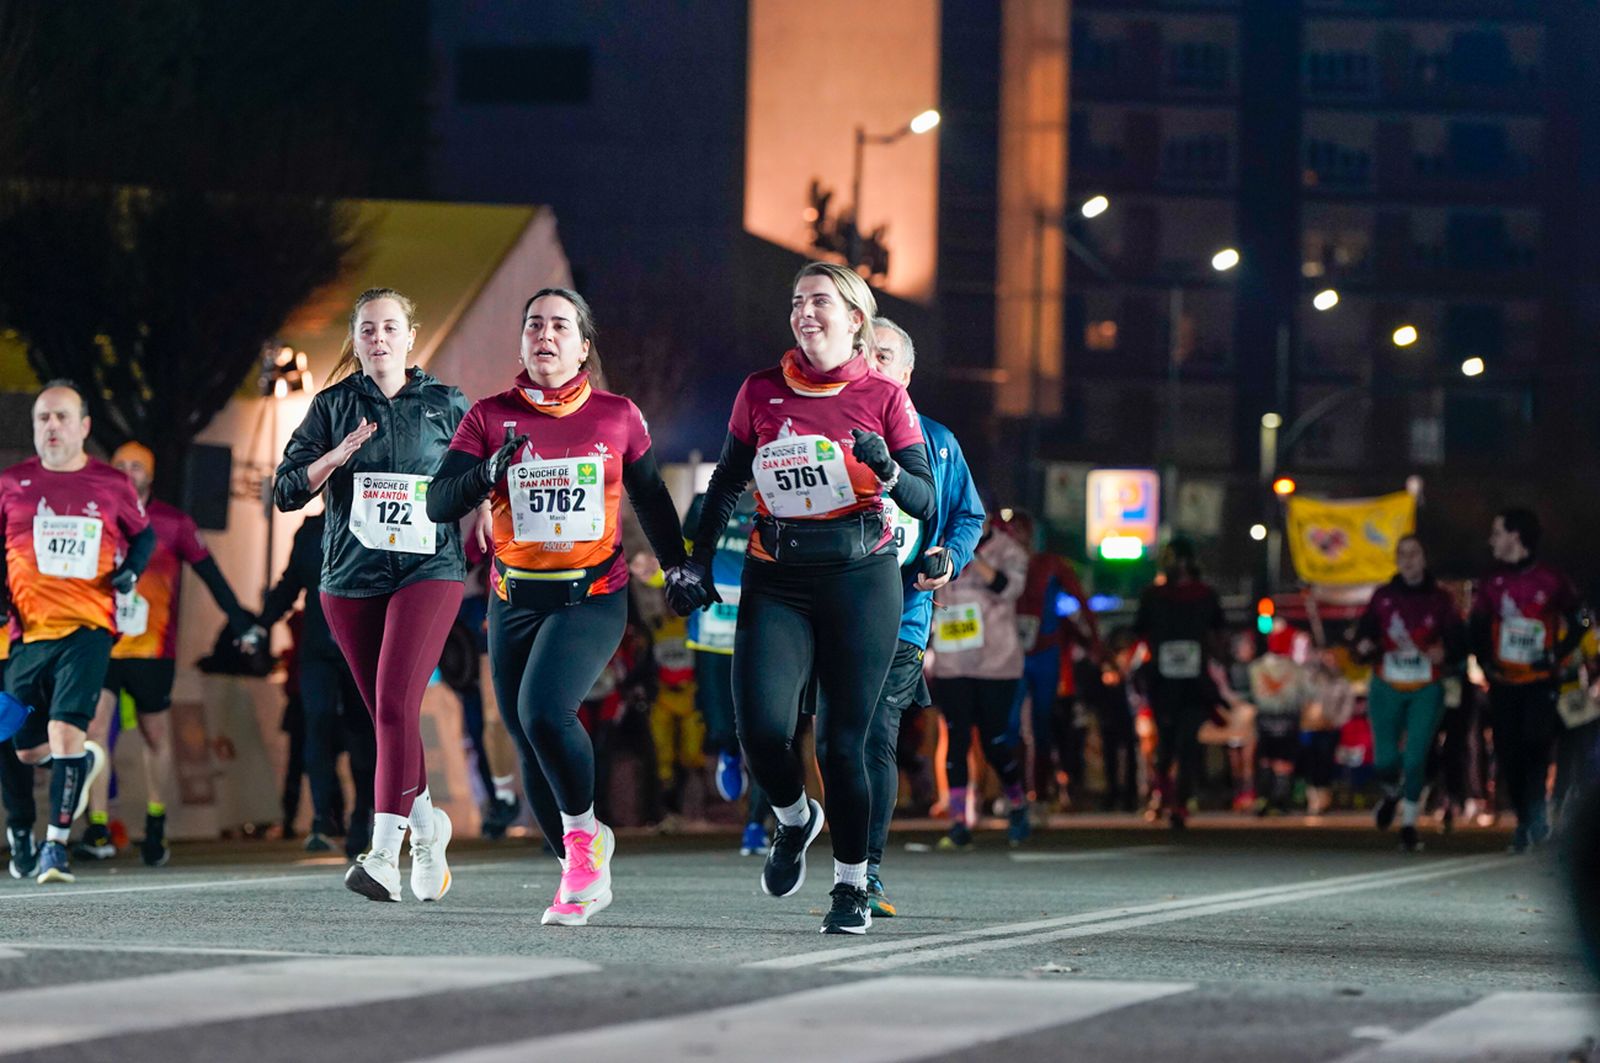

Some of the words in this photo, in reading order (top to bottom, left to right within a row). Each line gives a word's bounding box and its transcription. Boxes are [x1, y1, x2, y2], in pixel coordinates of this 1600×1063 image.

[771, 447, 796, 457] NOCHE
[797, 445, 808, 455] DE
[761, 459, 779, 470] SAN
[529, 469, 557, 479] NOCHE
[558, 467, 570, 477] DE
[774, 464, 829, 491] 5761
[372, 481, 398, 491] NOCHE
[399, 483, 409, 491] DE
[519, 480, 538, 489] SAN
[539, 476, 570, 488] ANTÓN
[362, 490, 378, 499] SAN
[380, 489, 409, 500] ANTÓN
[529, 488, 586, 513] 5762
[377, 501, 413, 525] 122
[48, 538, 86, 556] 4724
